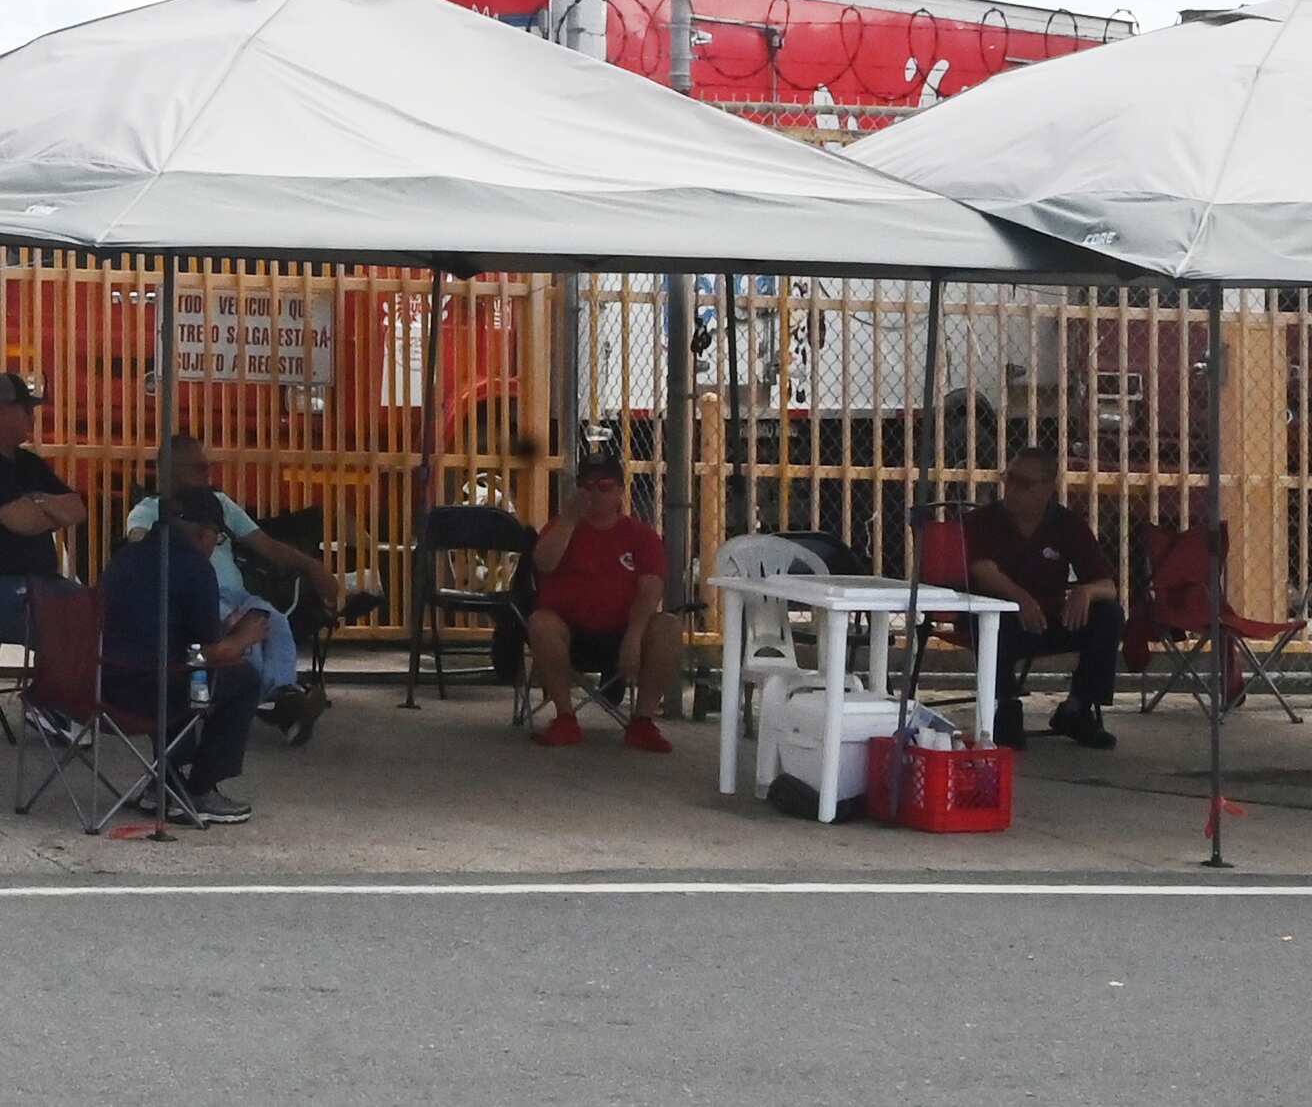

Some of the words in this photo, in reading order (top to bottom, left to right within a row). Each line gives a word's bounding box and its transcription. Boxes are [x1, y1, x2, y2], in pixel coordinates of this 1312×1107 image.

[178, 295, 210, 314] TOD
[226, 326, 270, 347] SLGA
[176, 352, 225, 372] SUJEO
